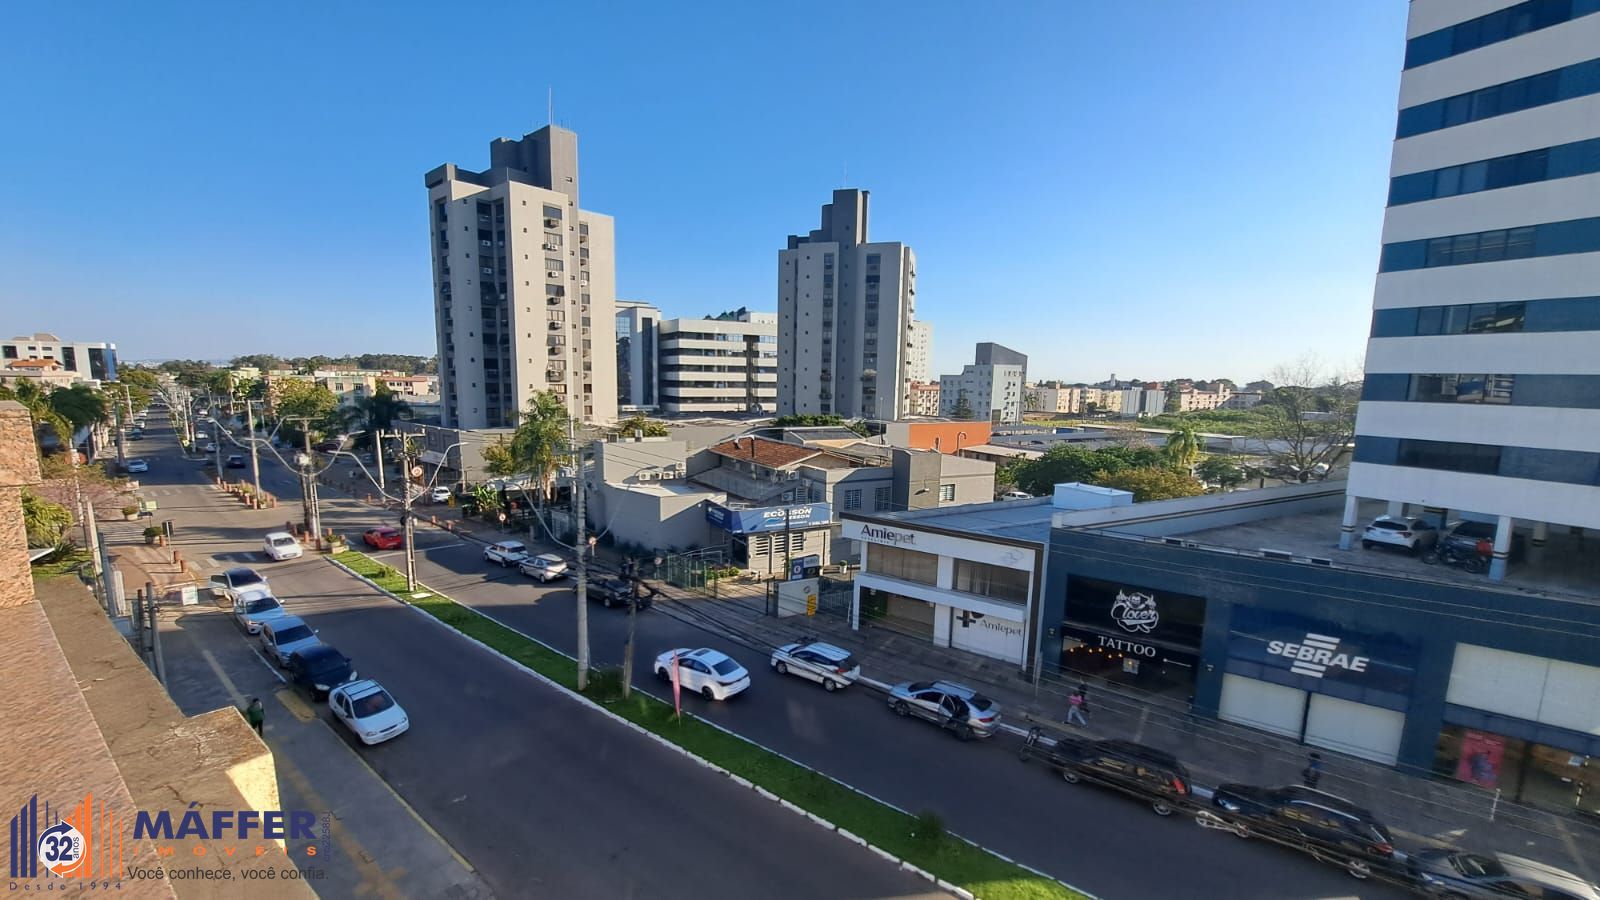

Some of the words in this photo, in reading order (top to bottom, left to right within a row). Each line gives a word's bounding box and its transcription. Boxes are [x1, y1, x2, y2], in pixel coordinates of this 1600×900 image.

[861, 523, 916, 545] Amiepet
[1098, 635, 1156, 658] TATTOO
[1266, 640, 1370, 673] SEBRAE
